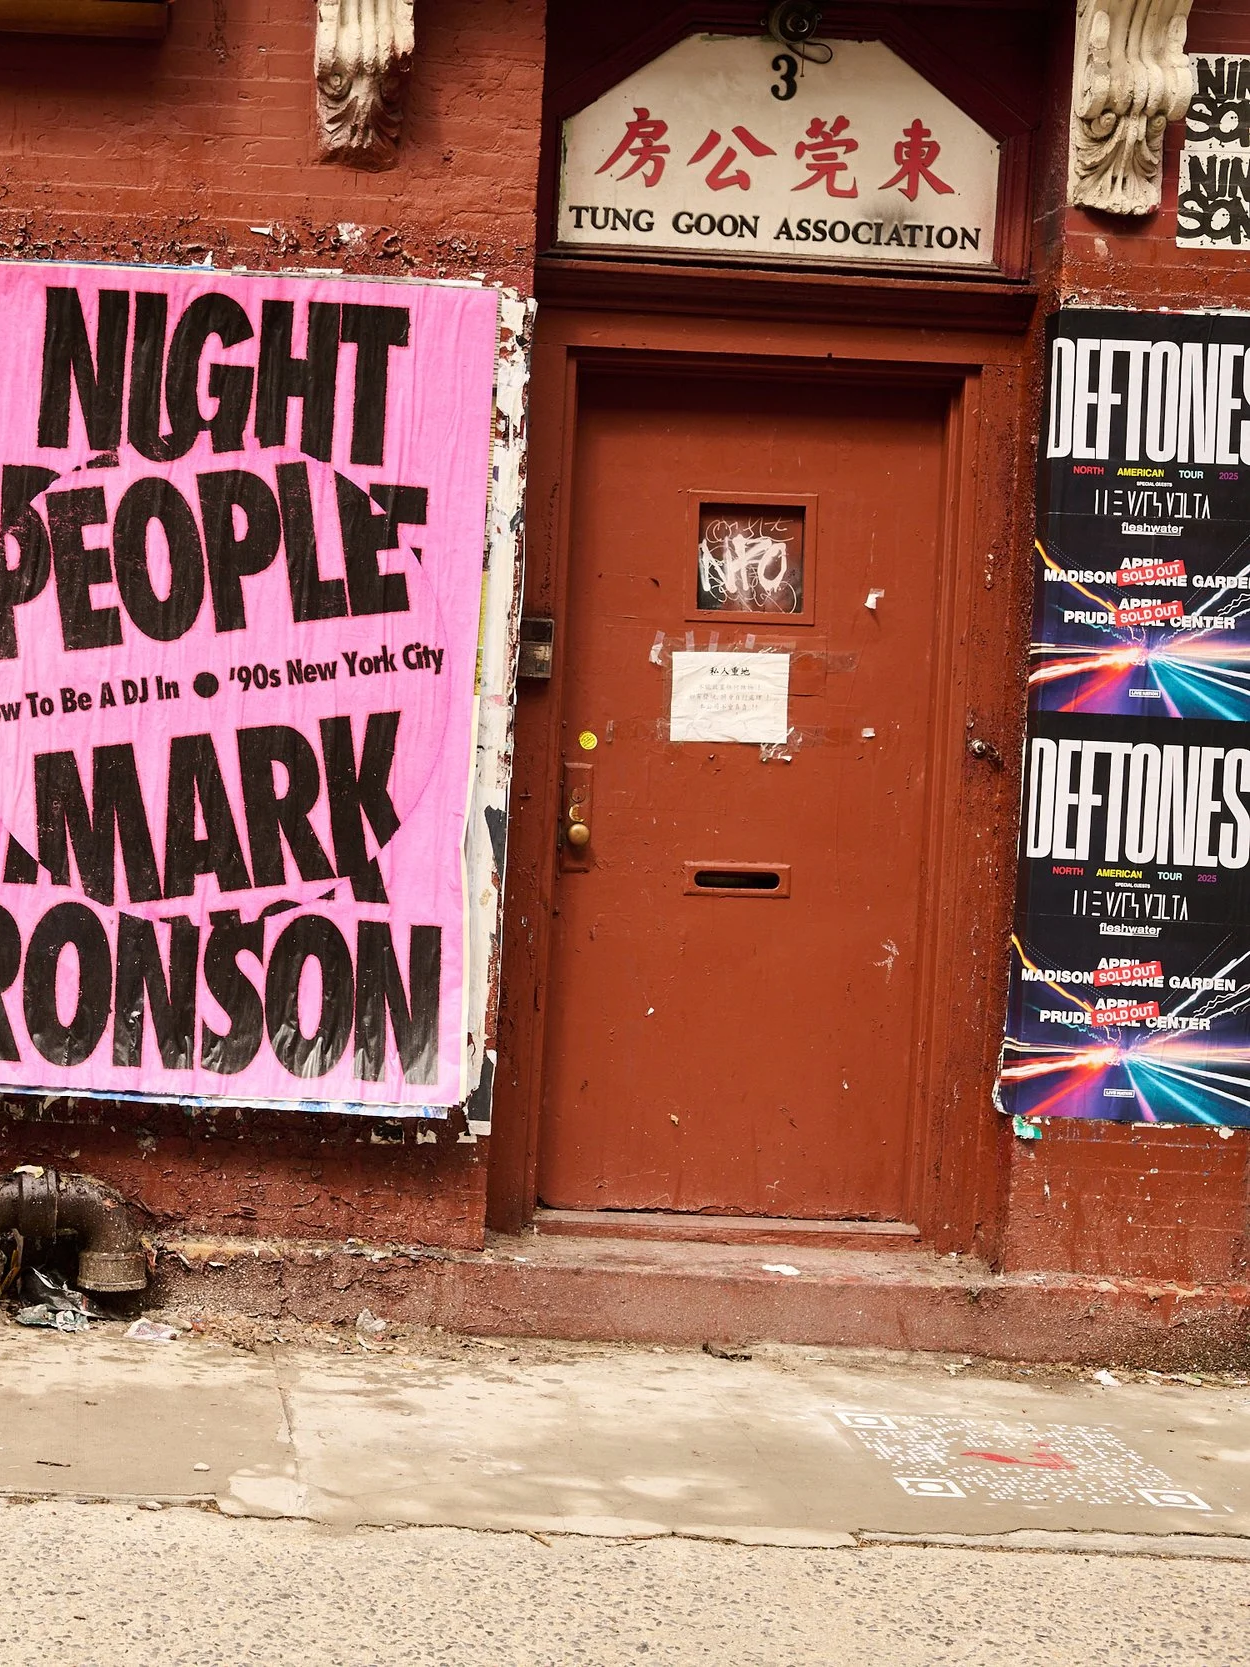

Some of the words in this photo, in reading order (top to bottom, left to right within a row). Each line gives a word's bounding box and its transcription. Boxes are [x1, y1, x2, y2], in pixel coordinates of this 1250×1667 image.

[770, 53, 798, 100] 3
[568, 204, 654, 232] TUNG
[672, 210, 760, 239] GOON
[773, 217, 982, 250] ASSOCIATION
[37, 286, 410, 467] NIGHT
[1046, 336, 1250, 467] DEFTONE
[1073, 466, 1104, 476] NORTH
[1117, 467, 1164, 478] AMERICAN
[1179, 470, 1204, 479] TOUR
[1219, 472, 1239, 480] 2025
[1121, 522, 1184, 536] fleshwater
[1044, 568, 1117, 584] MADISON
[1192, 575, 1250, 590] GARDE
[1122, 568, 1154, 583] SOLD
[1156, 564, 1180, 577] OUT
[1120, 609, 1152, 624] SOLD
[1154, 605, 1178, 617] OUT
[1170, 615, 1236, 630] CENTER
[25, 692, 54, 718] To
[60, 687, 92, 713] Be
[100, 682, 116, 709] A
[122, 677, 149, 705] DJ
[155, 675, 180, 700] In
[229, 663, 281, 692] '90s
[286, 658, 338, 685] New
[342, 645, 398, 677] York
[402, 641, 445, 675] City
[2, 711, 400, 904] MARK
[1026, 737, 1250, 870] DEFTONES
[1052, 866, 1084, 876] NORTH
[1096, 868, 1142, 879] AMERICAN
[1158, 871, 1182, 881] TOUR
[1197, 874, 1217, 883] 2025
[1099, 922, 1162, 937] fleshwater
[1021, 968, 1094, 984] MADISON
[1169, 976, 1236, 991] GARDEN
[1099, 969, 1131, 983] SOLD
[1133, 965, 1156, 978] OUT
[1096, 1010, 1128, 1024] SOLD
[1130, 1005, 1154, 1018] OUT
[1145, 1016, 1211, 1031] CENTER
